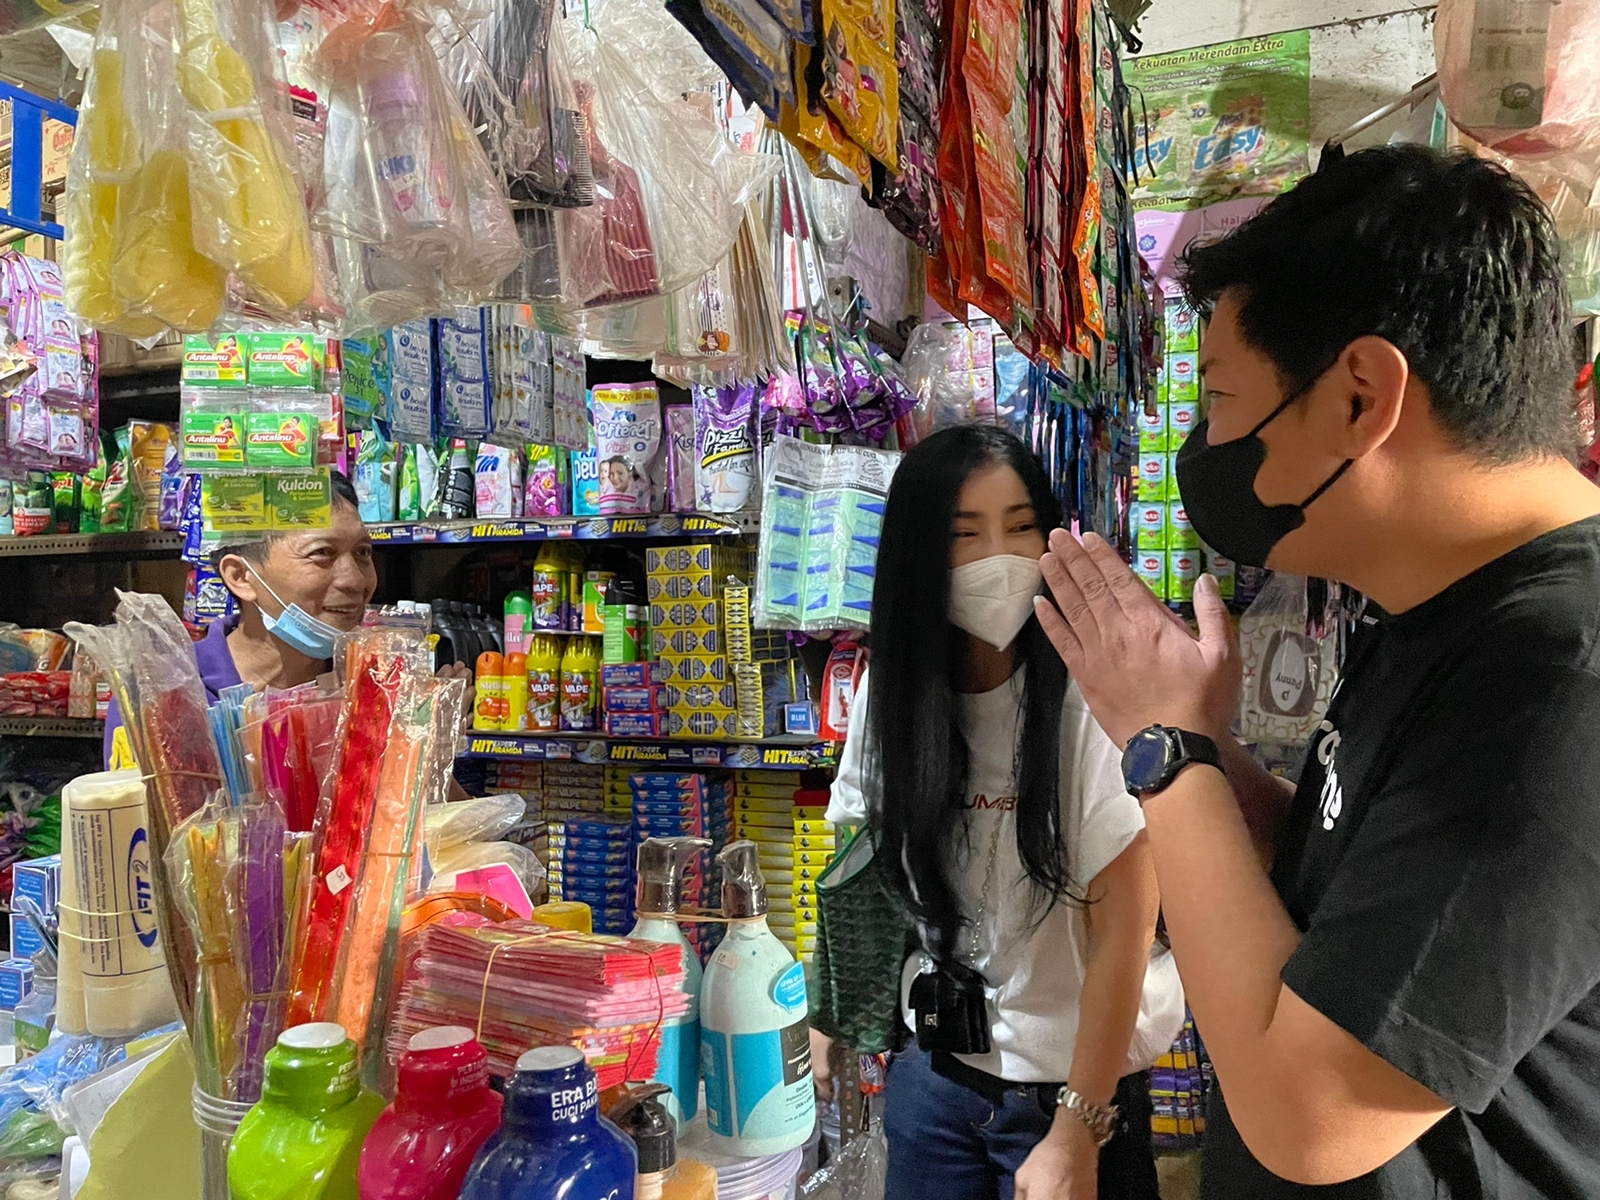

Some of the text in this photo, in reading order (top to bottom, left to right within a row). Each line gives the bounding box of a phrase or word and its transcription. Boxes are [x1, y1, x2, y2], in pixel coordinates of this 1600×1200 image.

[1133, 39, 1284, 71] Kekuatan Merendam Extra
[1192, 125, 1263, 171] Easy
[187, 435, 227, 444] Antalinu
[251, 433, 292, 443] Antalinu
[704, 425, 745, 453] Pizzi
[277, 479, 323, 493] Kuldon
[472, 524, 494, 537] HIT
[612, 519, 636, 533] HIT
[683, 518, 705, 530] HIT
[531, 684, 555, 692] VAPE
[564, 684, 588, 693] VAPE
[471, 740, 494, 752] HIT
[492, 746, 523, 754] PIRAMIDA
[610, 745, 635, 759] HIT
[633, 752, 667, 761] PIRAMIDA
[763, 750, 788, 763] HIT
[137, 876, 153, 914] FIT
[551, 1086, 583, 1108] ERA
[552, 1104, 578, 1122] CUCI
